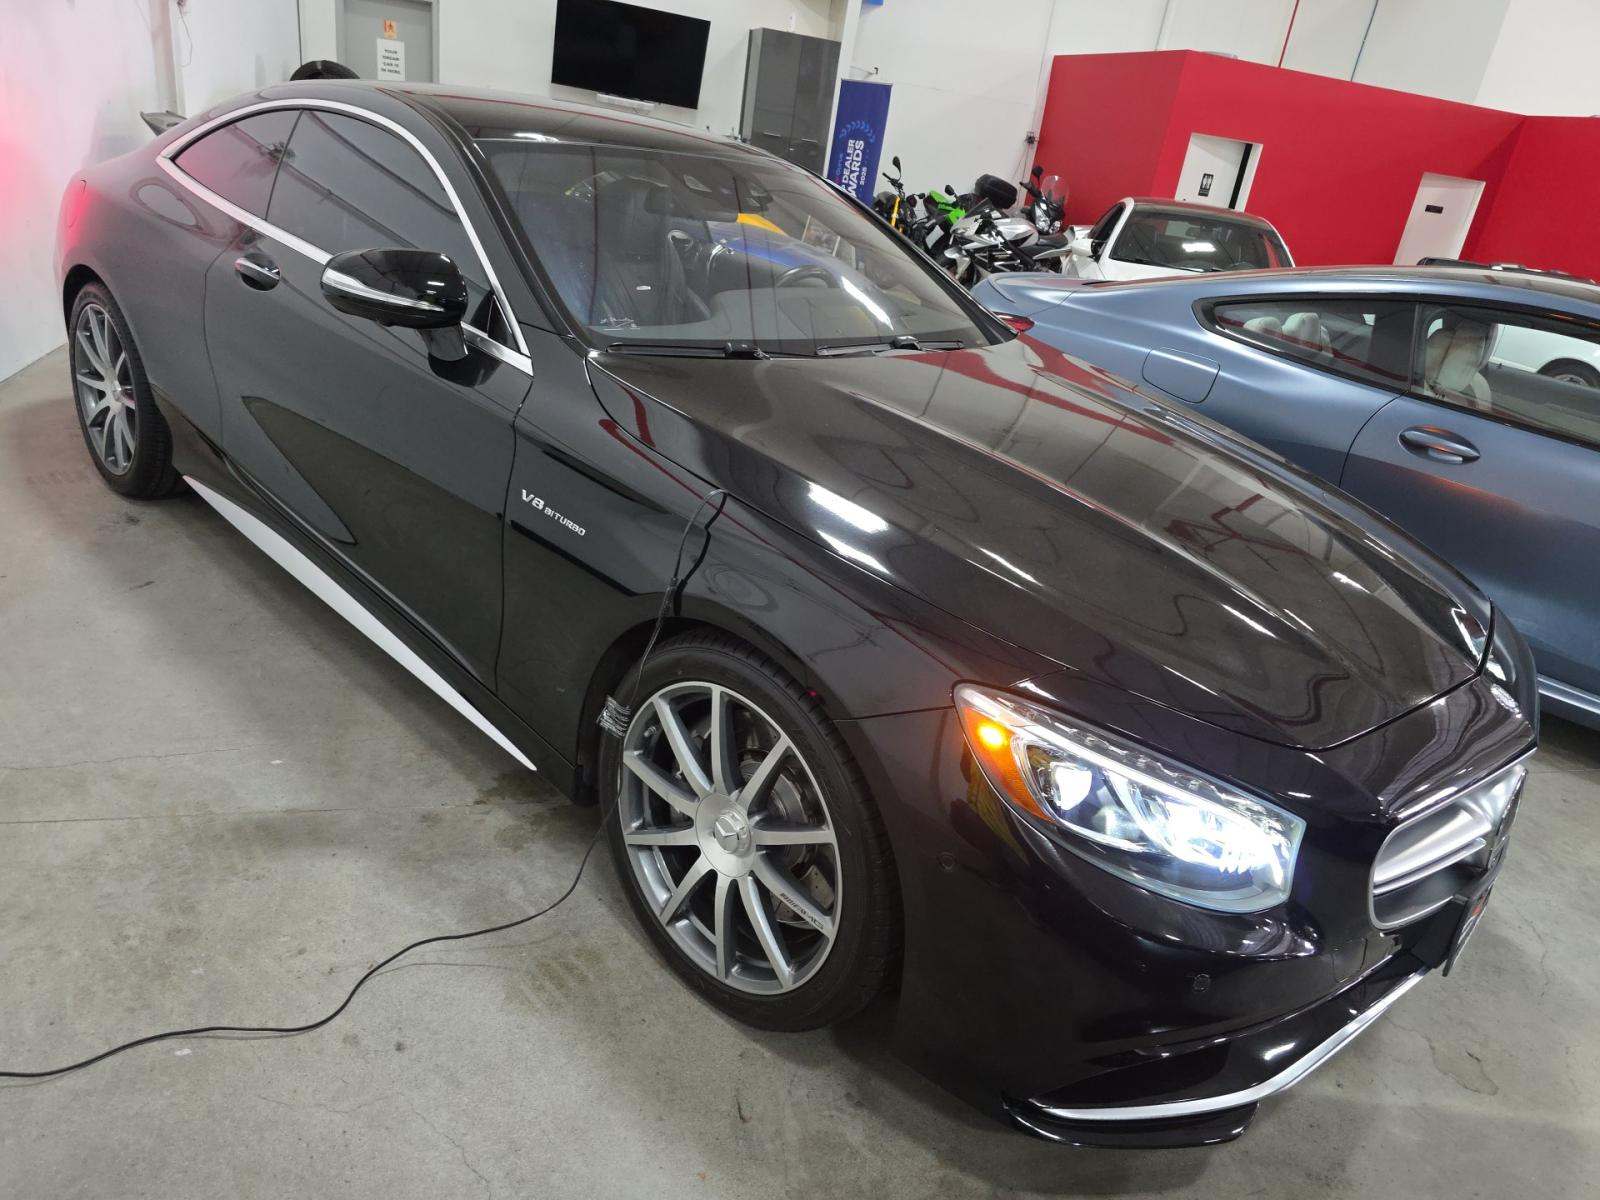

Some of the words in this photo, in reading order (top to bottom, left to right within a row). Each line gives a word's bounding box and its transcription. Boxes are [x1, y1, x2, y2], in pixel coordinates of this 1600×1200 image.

[842, 139, 856, 184] DEALER
[847, 140, 865, 199] WARDS
[522, 489, 545, 510] V8
[544, 507, 586, 536] BITURBO
